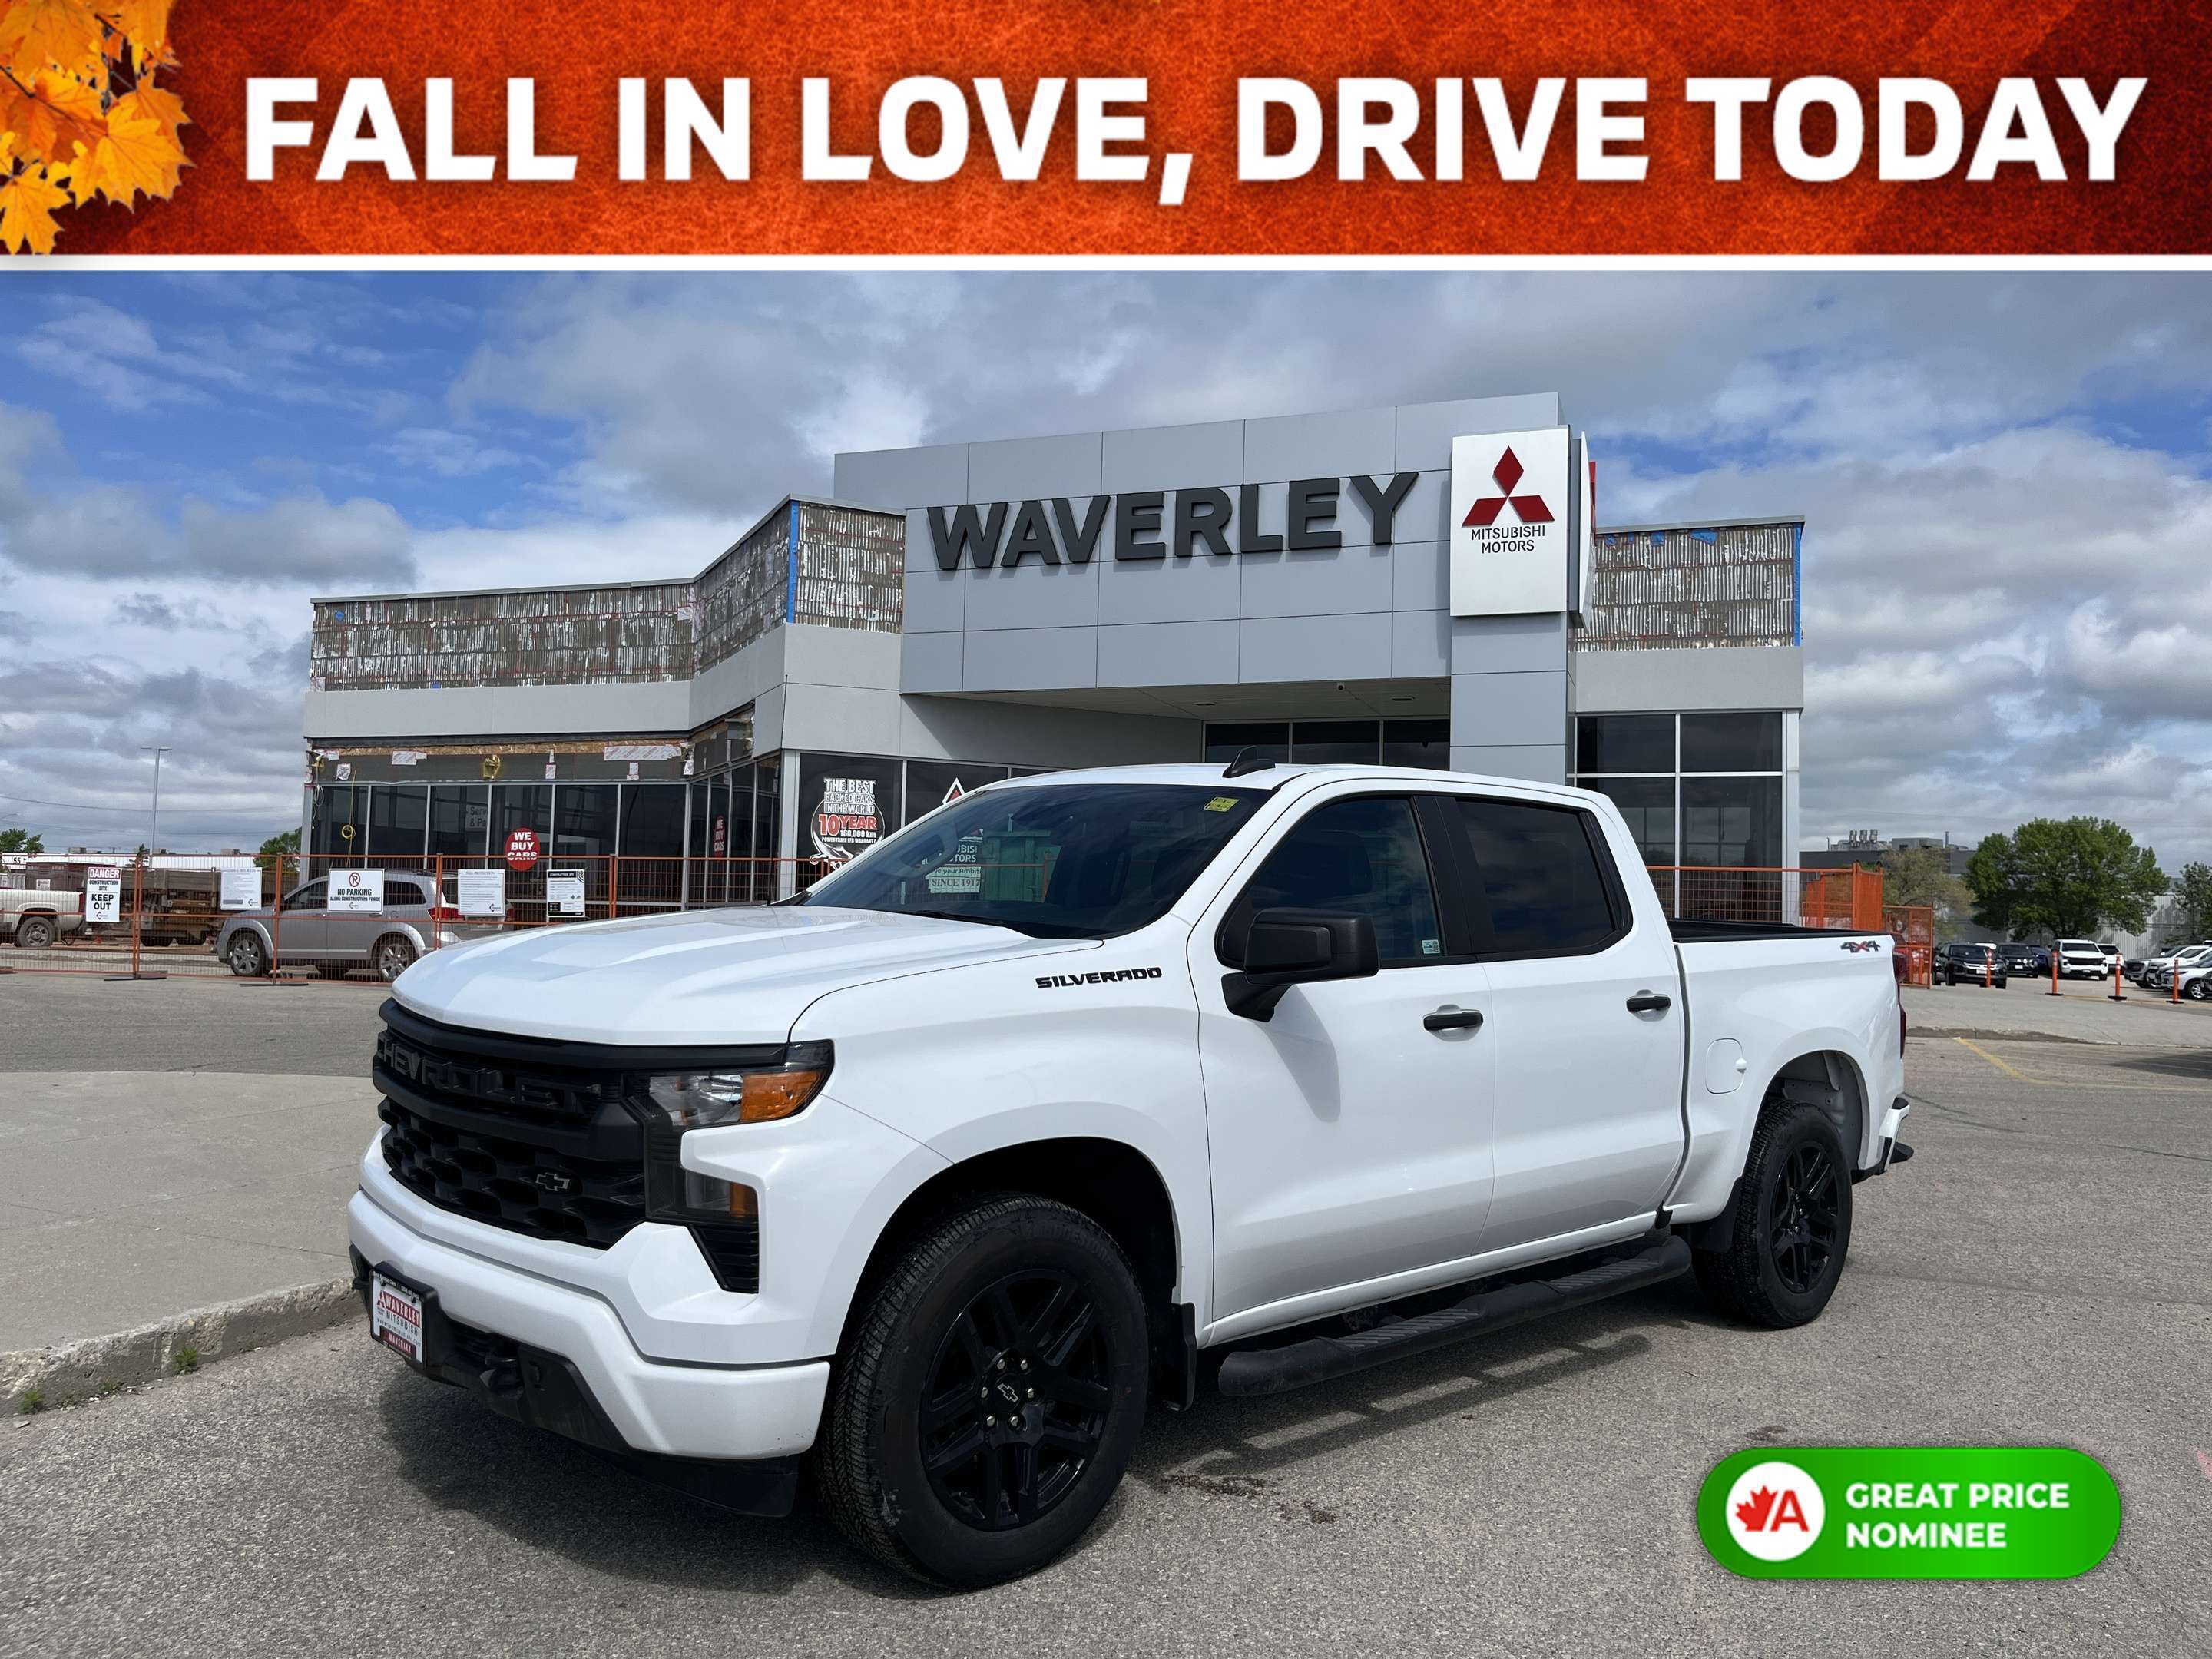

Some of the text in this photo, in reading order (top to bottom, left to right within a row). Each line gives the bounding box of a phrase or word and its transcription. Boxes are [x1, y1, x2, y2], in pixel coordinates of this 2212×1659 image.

[927, 472, 1419, 571] WAVERLEY
[1471, 525, 1545, 541] MITSUBISHI
[1482, 540, 1535, 554] MOTORS
[824, 778, 876, 794] THE BEST
[824, 793, 875, 804] BACKED CARS
[824, 803, 875, 815] IN THE WORLD
[819, 814, 877, 836] 10 YEAR
[514, 832, 531, 840] WE
[511, 842, 535, 851] BUY
[507, 851, 538, 861] CARS
[90, 869, 119, 878] DANGER
[932, 878, 959, 886] SINCE
[91, 893, 114, 902] KEEP
[346, 888, 373, 896] PARKING
[94, 902, 111, 910] OUT
[1035, 967, 1163, 989] SILVERADO
[386, 1294, 420, 1327] WAVERLEY
[386, 1310, 420, 1338] MITSUBISHI
